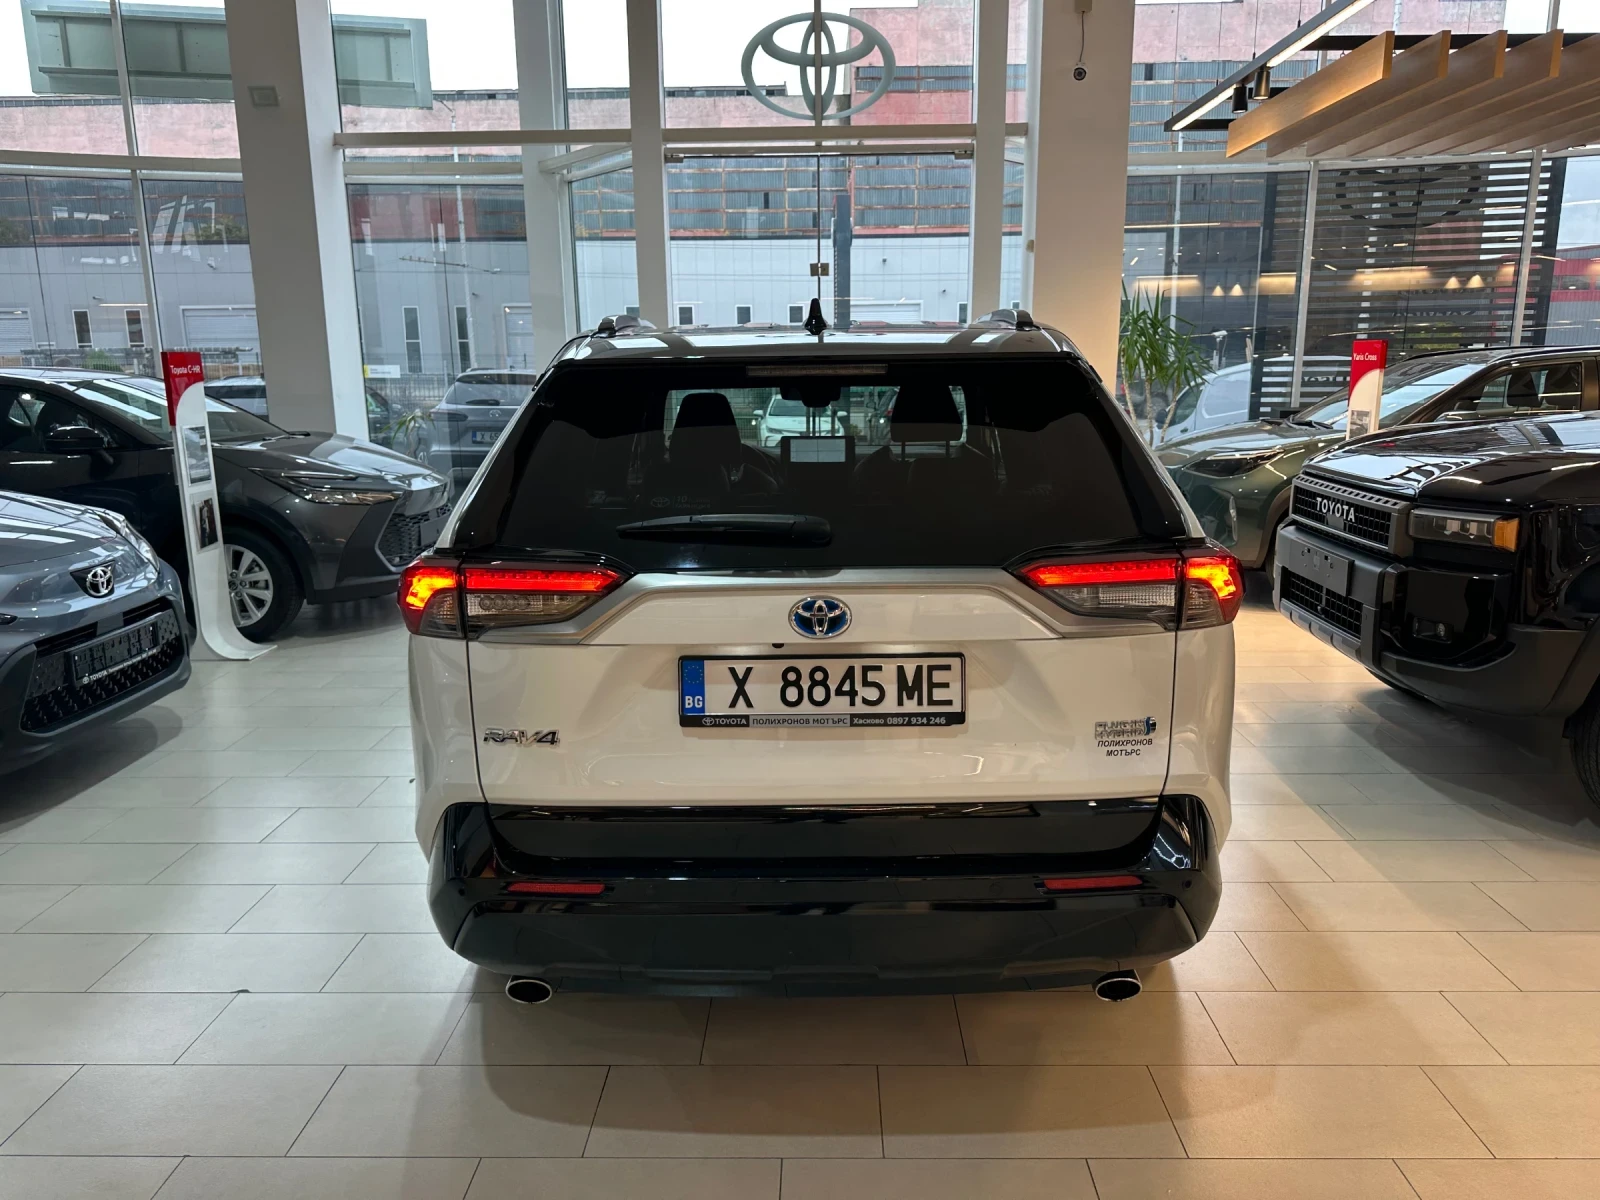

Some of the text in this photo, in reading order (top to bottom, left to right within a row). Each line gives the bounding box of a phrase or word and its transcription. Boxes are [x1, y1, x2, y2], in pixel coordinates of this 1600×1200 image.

[1353, 352, 1377, 361] Yaris Cross
[170, 364, 201, 375] Toyota C-HR
[1316, 497, 1355, 523] TOYOTA
[90, 669, 108, 680] TOYOTA
[727, 664, 953, 709] X 8845 ME
[685, 695, 703, 709] BG
[714, 717, 747, 725] TOYOTA
[812, 717, 848, 725] МОТЪРС
[853, 716, 946, 725] Хасково 0897 934 246
[483, 727, 560, 746] RAV4
[1097, 738, 1153, 748] ПОЛИХРОНОВ
[1106, 748, 1141, 757] МОТЪРС
